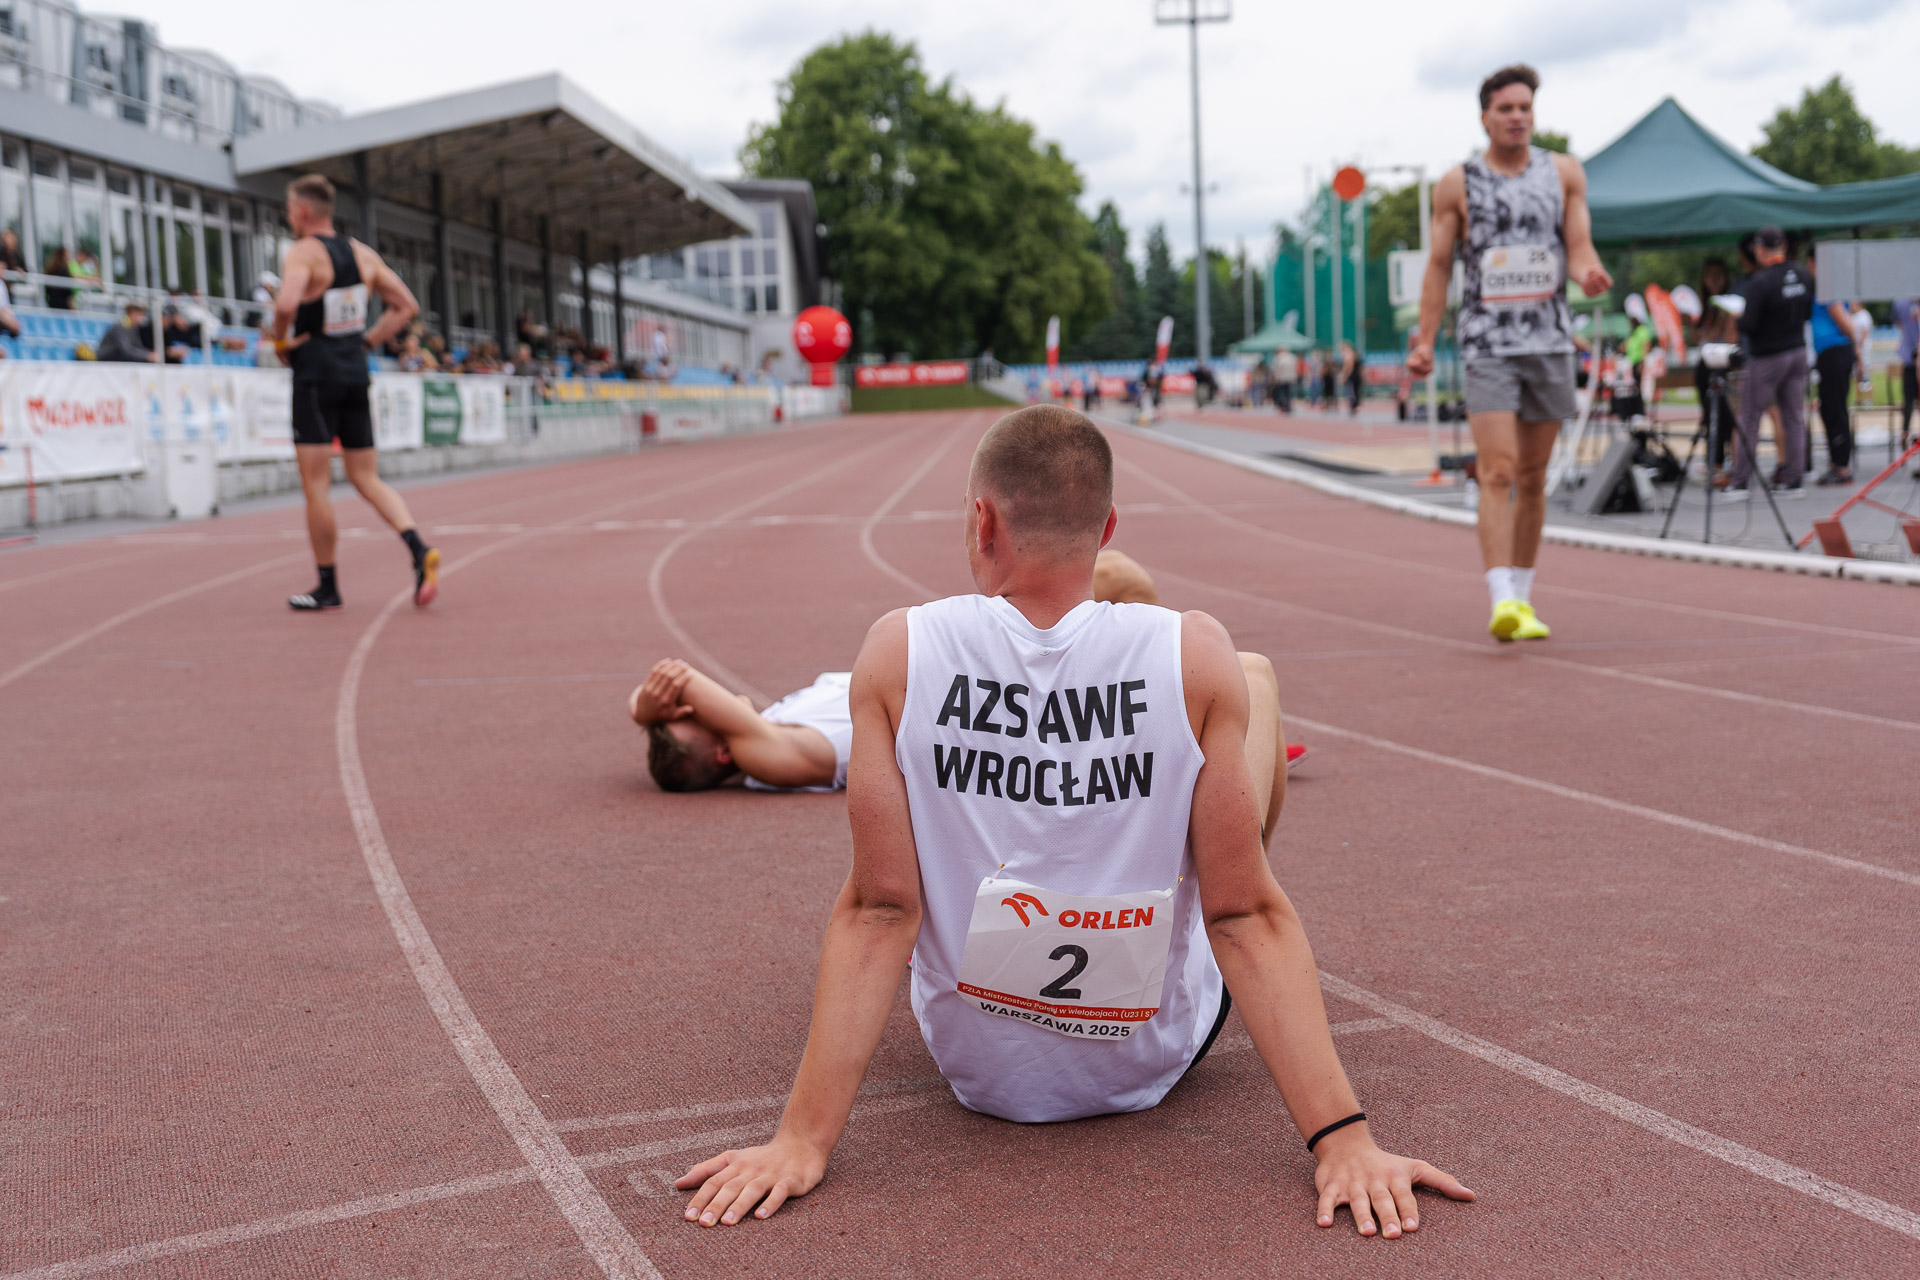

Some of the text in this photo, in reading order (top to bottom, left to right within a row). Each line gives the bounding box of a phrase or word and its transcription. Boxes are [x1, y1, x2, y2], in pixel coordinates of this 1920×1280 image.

[936, 673, 1148, 744] AZS AWF
[933, 743, 1154, 807] WROCŁAW
[1058, 906, 1155, 930] ORLEN
[1039, 944, 1089, 1000] 2
[980, 1001, 1131, 1037] WARSZAWA 2025
[983, 990, 1033, 1008] Mistrzostwa
[1068, 1007, 1119, 1019] wielobojach
